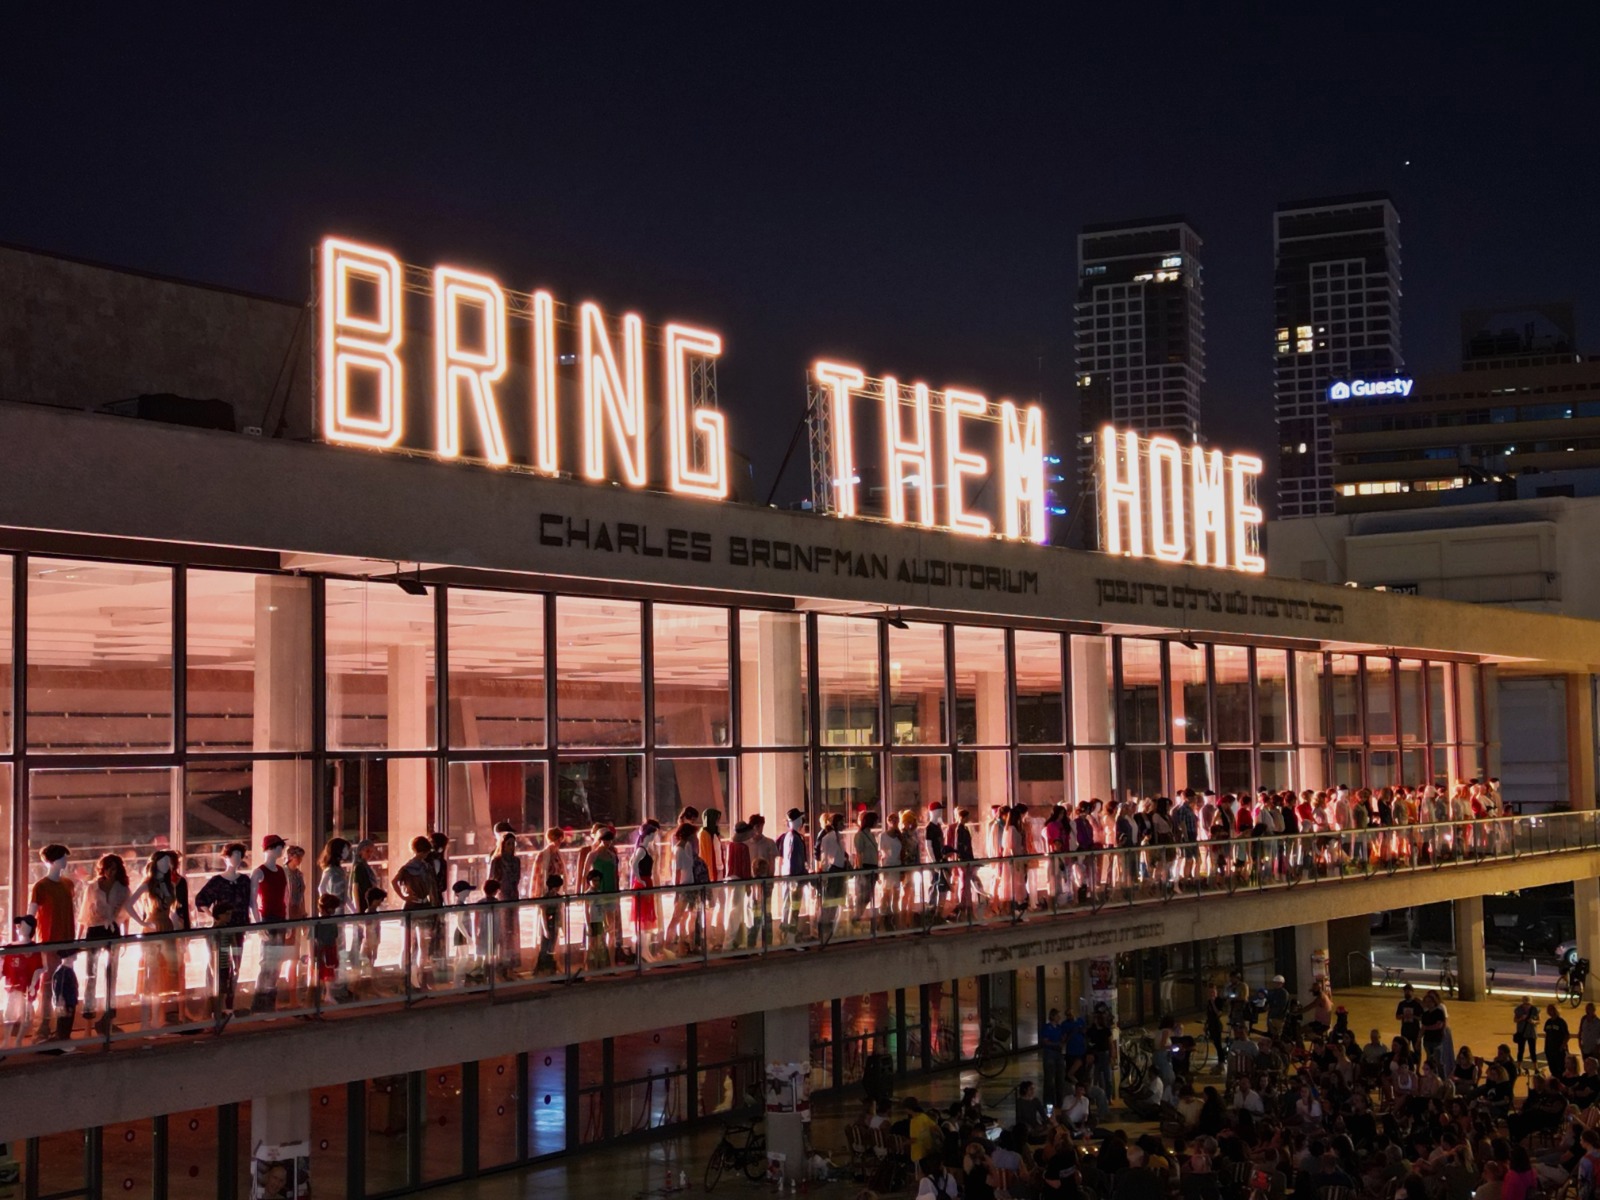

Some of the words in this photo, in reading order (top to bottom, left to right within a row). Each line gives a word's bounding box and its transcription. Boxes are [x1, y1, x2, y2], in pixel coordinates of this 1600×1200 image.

[321, 236, 728, 500] BRING
[815, 361, 1046, 543] THEM
[1101, 425, 1266, 573] HOME
[1351, 378, 1413, 397] Guesty
[539, 512, 712, 563] CHARLES
[729, 536, 889, 581] BRONFMAN
[897, 557, 1038, 595] AUDITORIUM
[1096, 578, 1168, 607] ברונפמן
